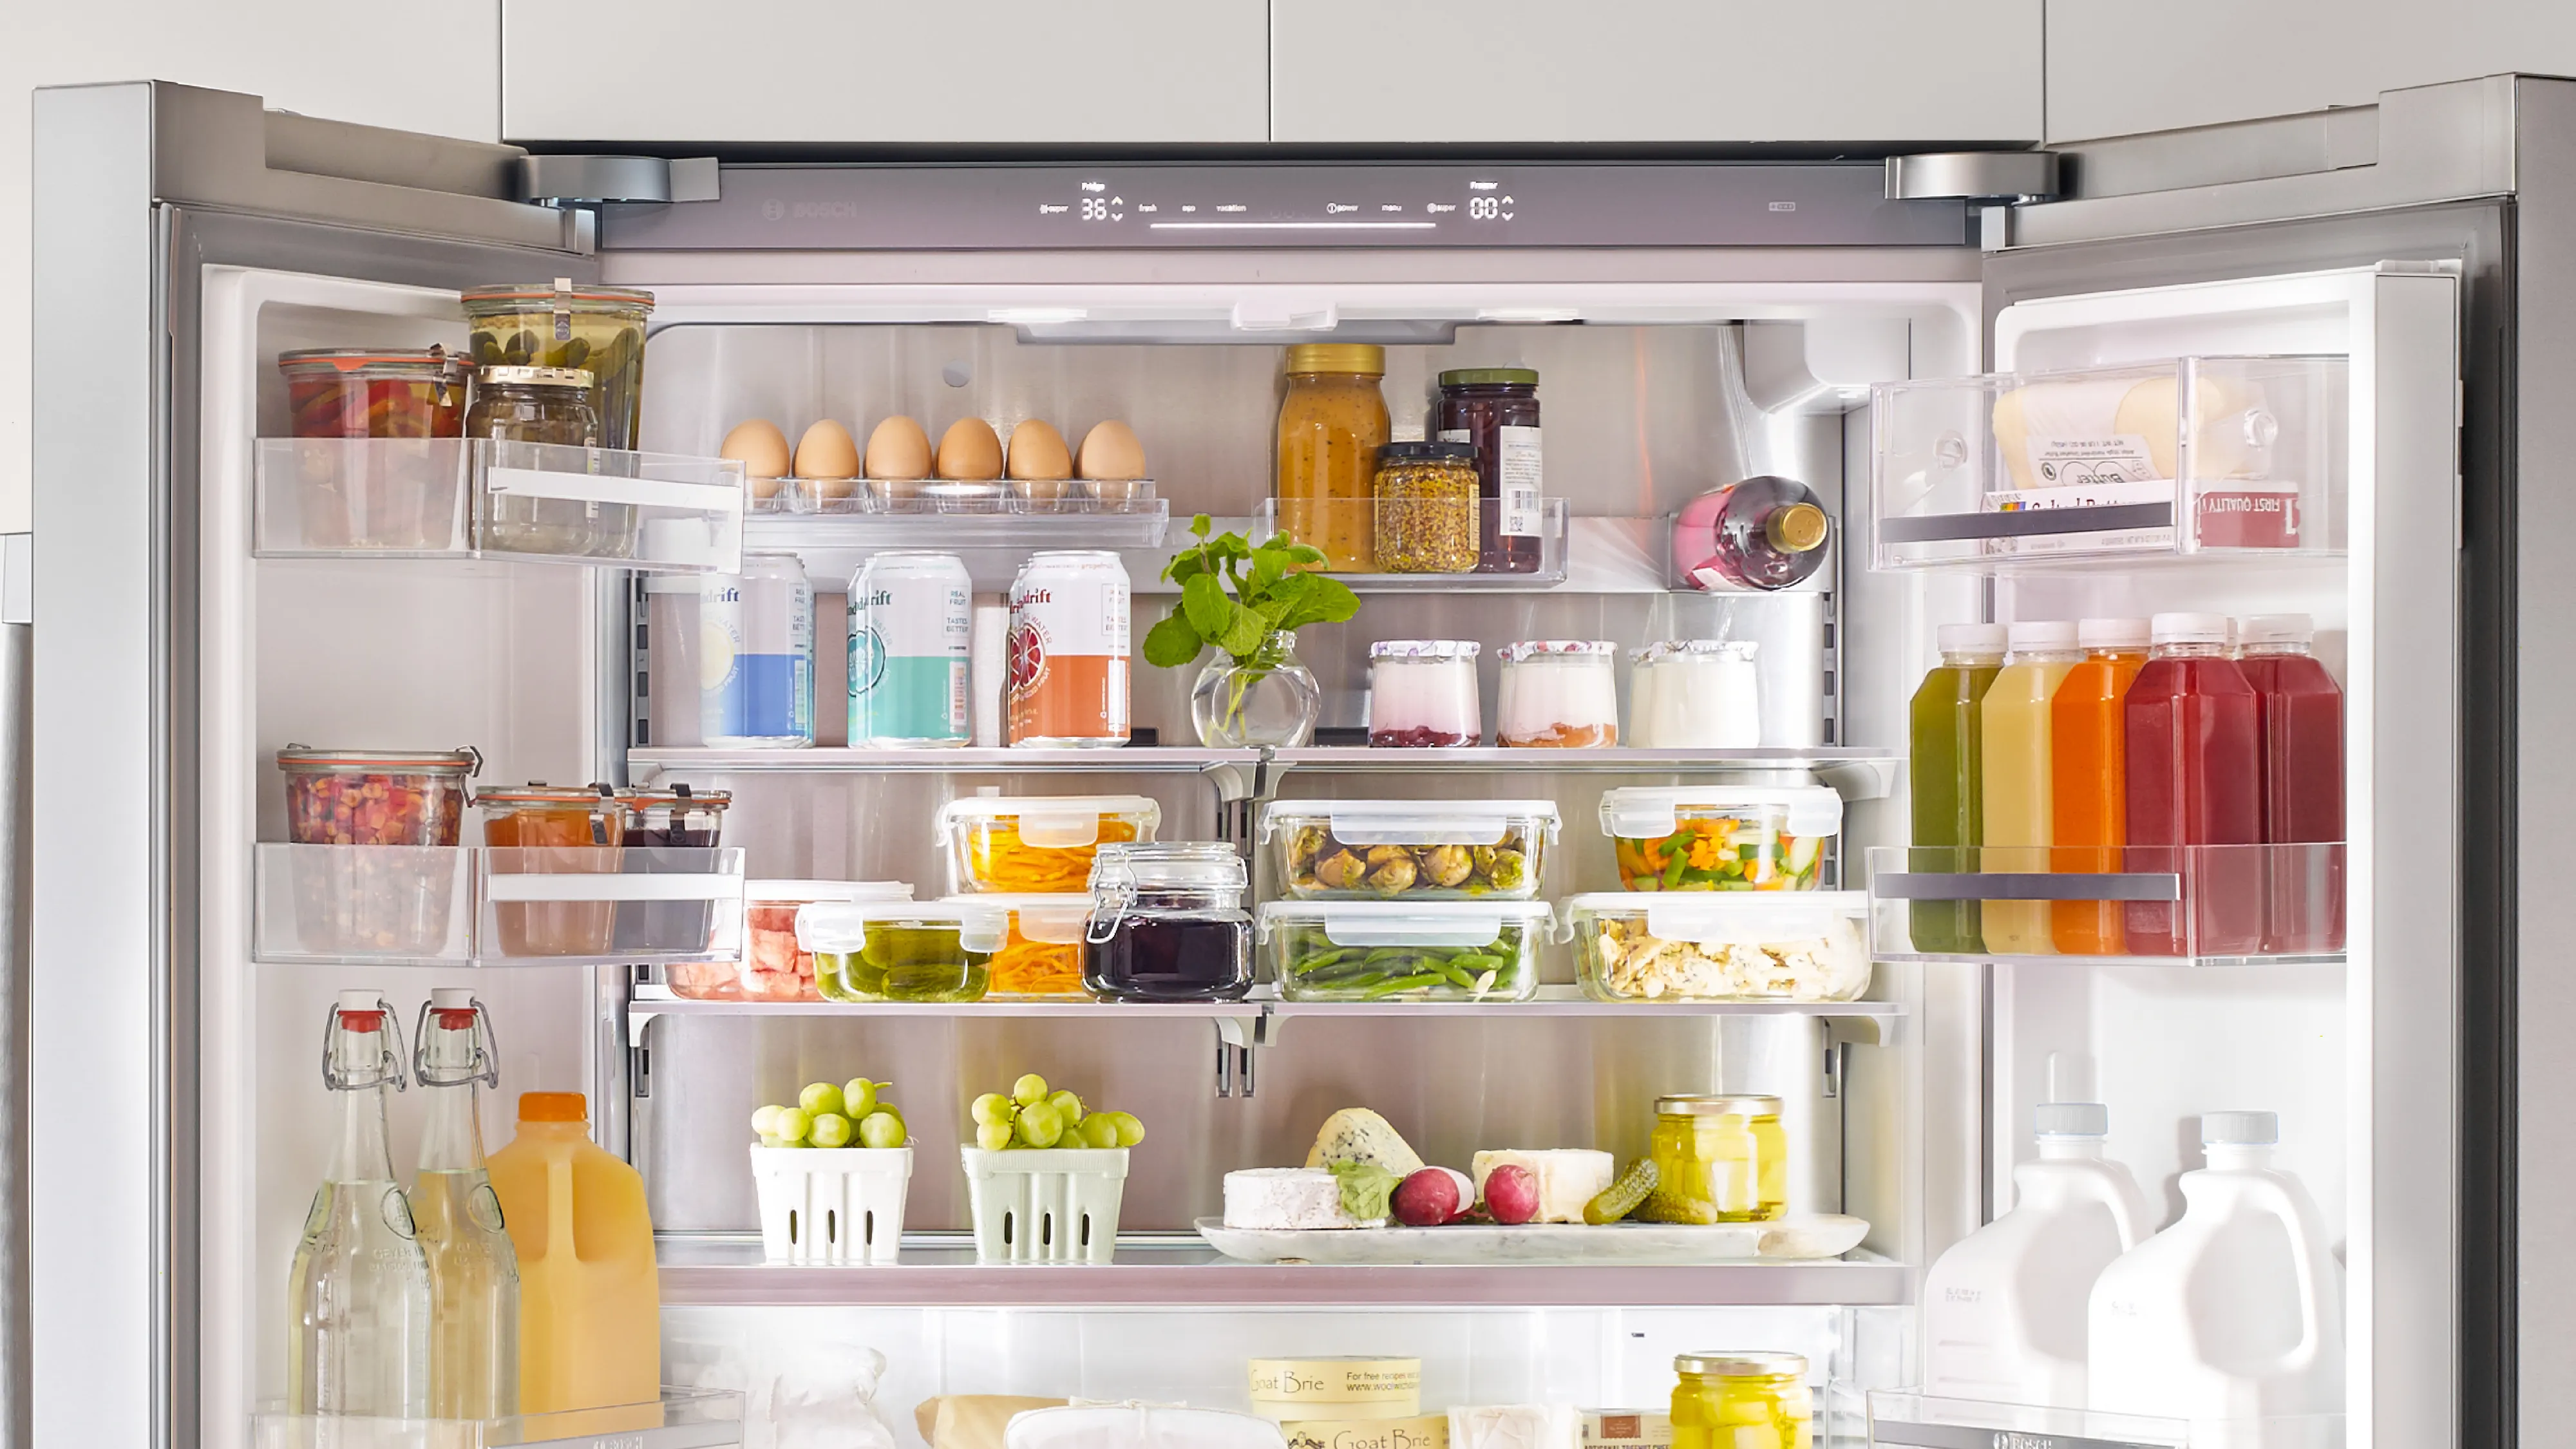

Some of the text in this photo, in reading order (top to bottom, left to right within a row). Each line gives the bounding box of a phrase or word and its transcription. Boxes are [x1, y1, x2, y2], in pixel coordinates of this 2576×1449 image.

[1081, 198, 1107, 220] 36
[1470, 196, 1499, 220] 00
[2209, 497, 2280, 513] FIRST QUALITY
[1250, 1369, 1324, 1393] Goat Brie
[1347, 1372, 1361, 1381] For
[1363, 1372, 1380, 1381] free
[1334, 1430, 1387, 1449] Goat
[1392, 1428, 1431, 1449] Brie
